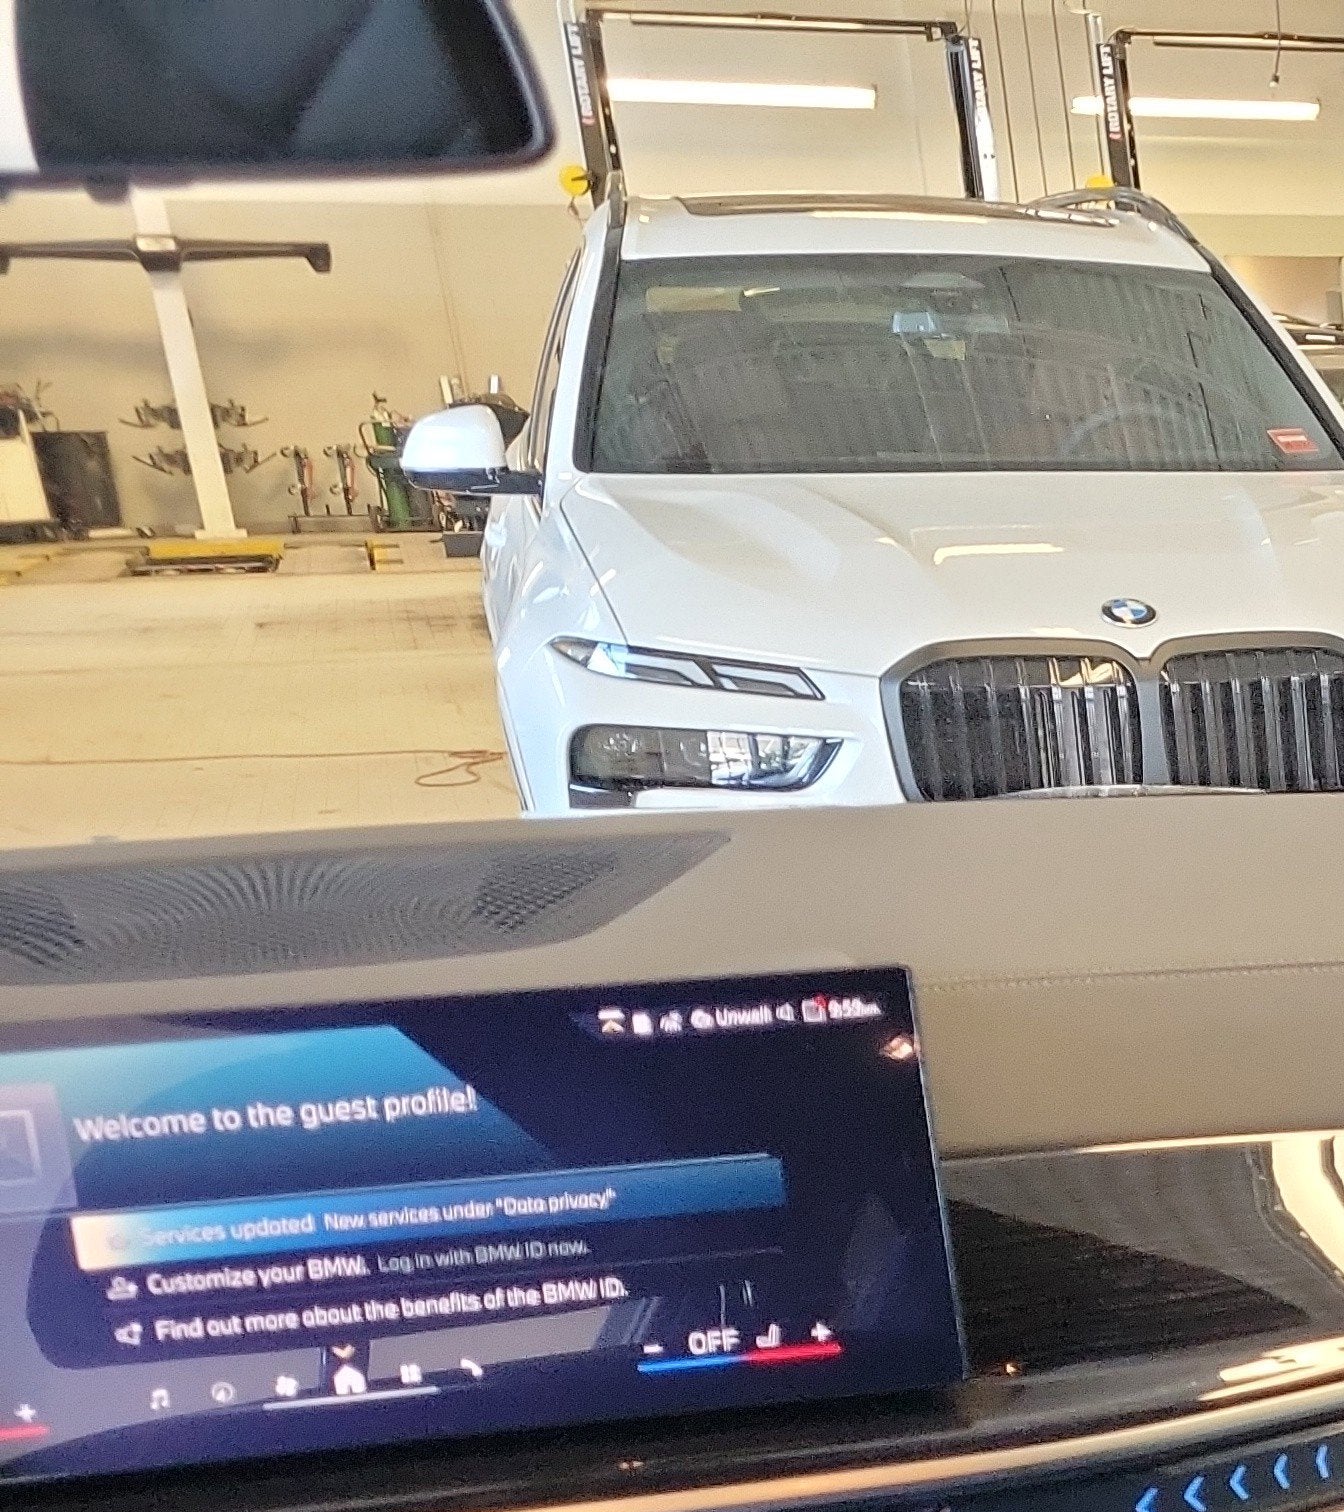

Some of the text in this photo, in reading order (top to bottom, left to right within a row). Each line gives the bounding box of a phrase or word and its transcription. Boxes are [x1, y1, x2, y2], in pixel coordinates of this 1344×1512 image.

[72, 1083, 479, 1143] Welcome to the guest profile!
[231, 1213, 317, 1243] updated
[323, 1211, 366, 1232] New
[368, 1203, 440, 1228] services
[441, 1198, 494, 1222] under
[146, 1266, 258, 1296] Customize
[257, 1264, 305, 1288] your
[377, 1253, 415, 1275] Log
[415, 1251, 432, 1269] in
[436, 1247, 473, 1267] with
[474, 1244, 523, 1265] BMW
[525, 1240, 544, 1260] ID
[153, 1316, 204, 1342] Find
[206, 1314, 244, 1338] out
[244, 1310, 300, 1333] more
[301, 1304, 365, 1329] about
[364, 1299, 400, 1322] the
[400, 1290, 482, 1319] benefits
[483, 1286, 507, 1311] of
[506, 1284, 542, 1308] the
[541, 1276, 599, 1305] BMW
[687, 1327, 741, 1356] OFF
